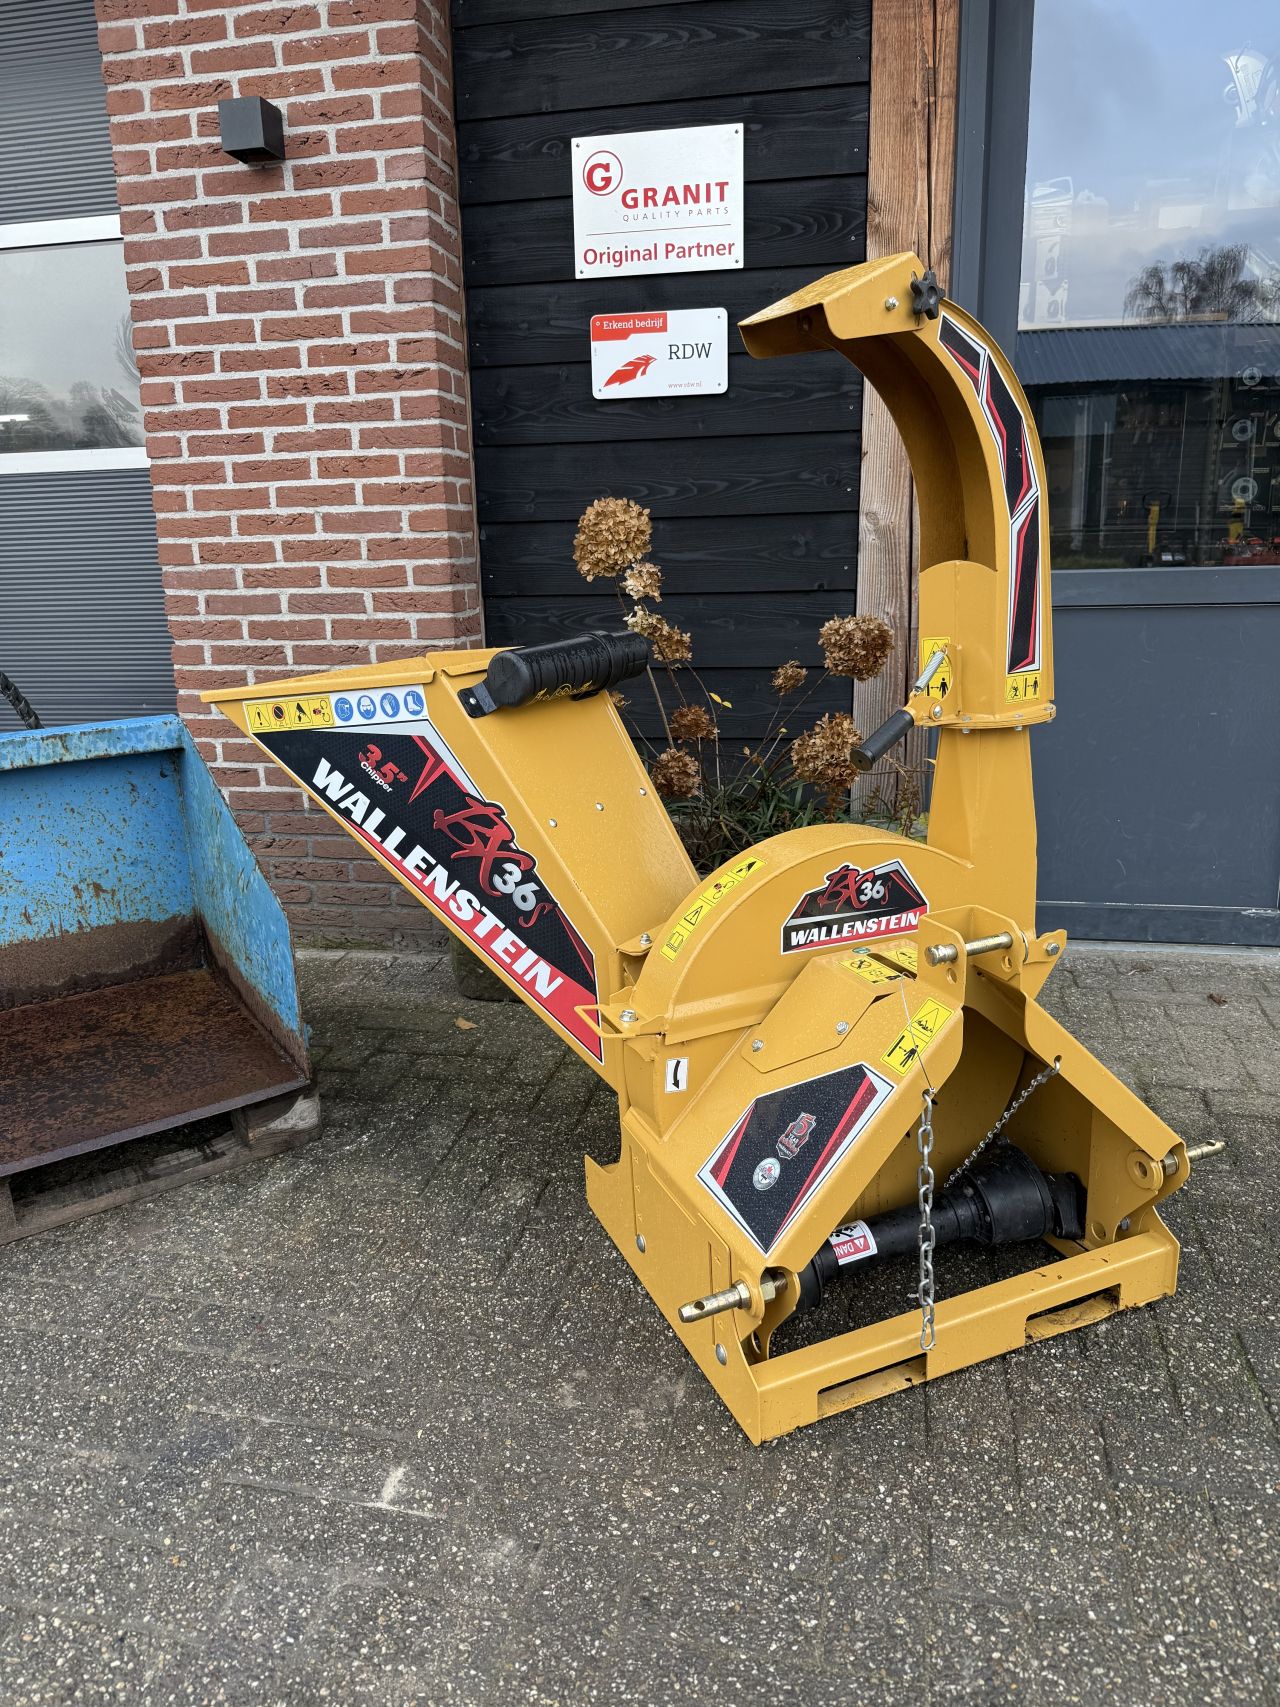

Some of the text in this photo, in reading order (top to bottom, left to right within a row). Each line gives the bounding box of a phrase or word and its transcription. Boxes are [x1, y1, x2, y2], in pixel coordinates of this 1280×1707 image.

[586, 162, 612, 192] G
[621, 181, 729, 210] GRANIT
[622, 206, 729, 222] QUALITY PARTS
[583, 241, 735, 268] Original Partner
[602, 317, 663, 330] Erkend bedrijf
[668, 342, 713, 360] RDW
[667, 380, 702, 389] www.rdw.nl
[360, 761, 393, 793] Chipper
[312, 757, 565, 1000] WALLENSTEIN
[790, 911, 919, 946] WALLENSTEIN
